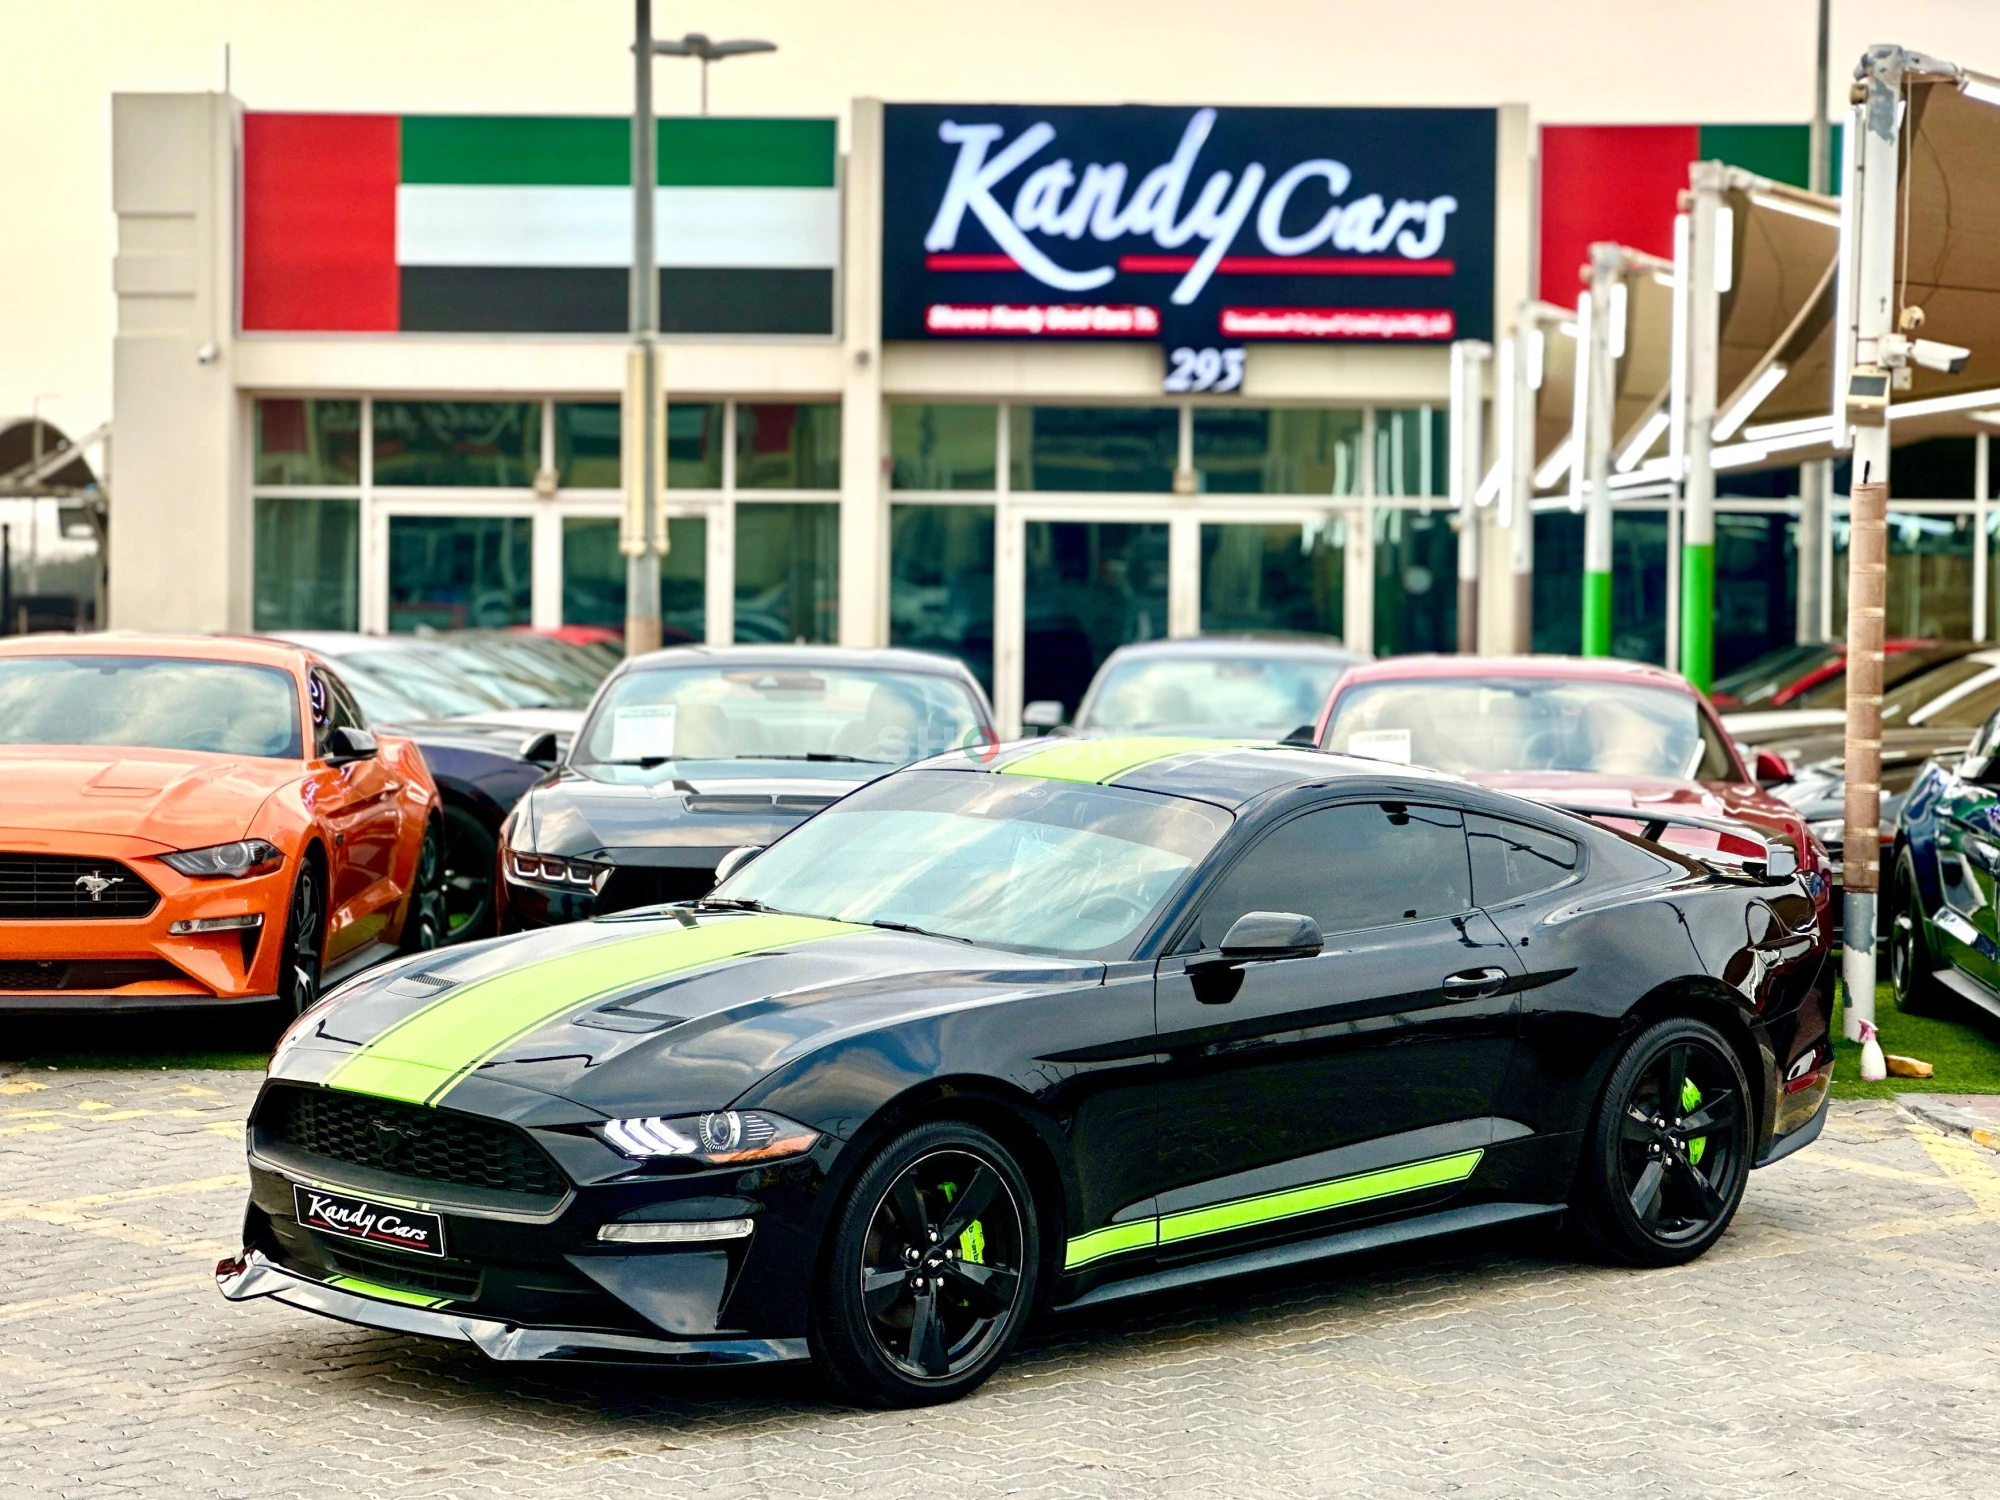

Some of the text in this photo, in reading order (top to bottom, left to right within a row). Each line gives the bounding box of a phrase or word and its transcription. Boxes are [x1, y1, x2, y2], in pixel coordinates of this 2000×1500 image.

[924, 107, 1458, 305] Kandy Cars
[1163, 346, 1247, 393] 295
[308, 1193, 428, 1240] Kandy Cars
